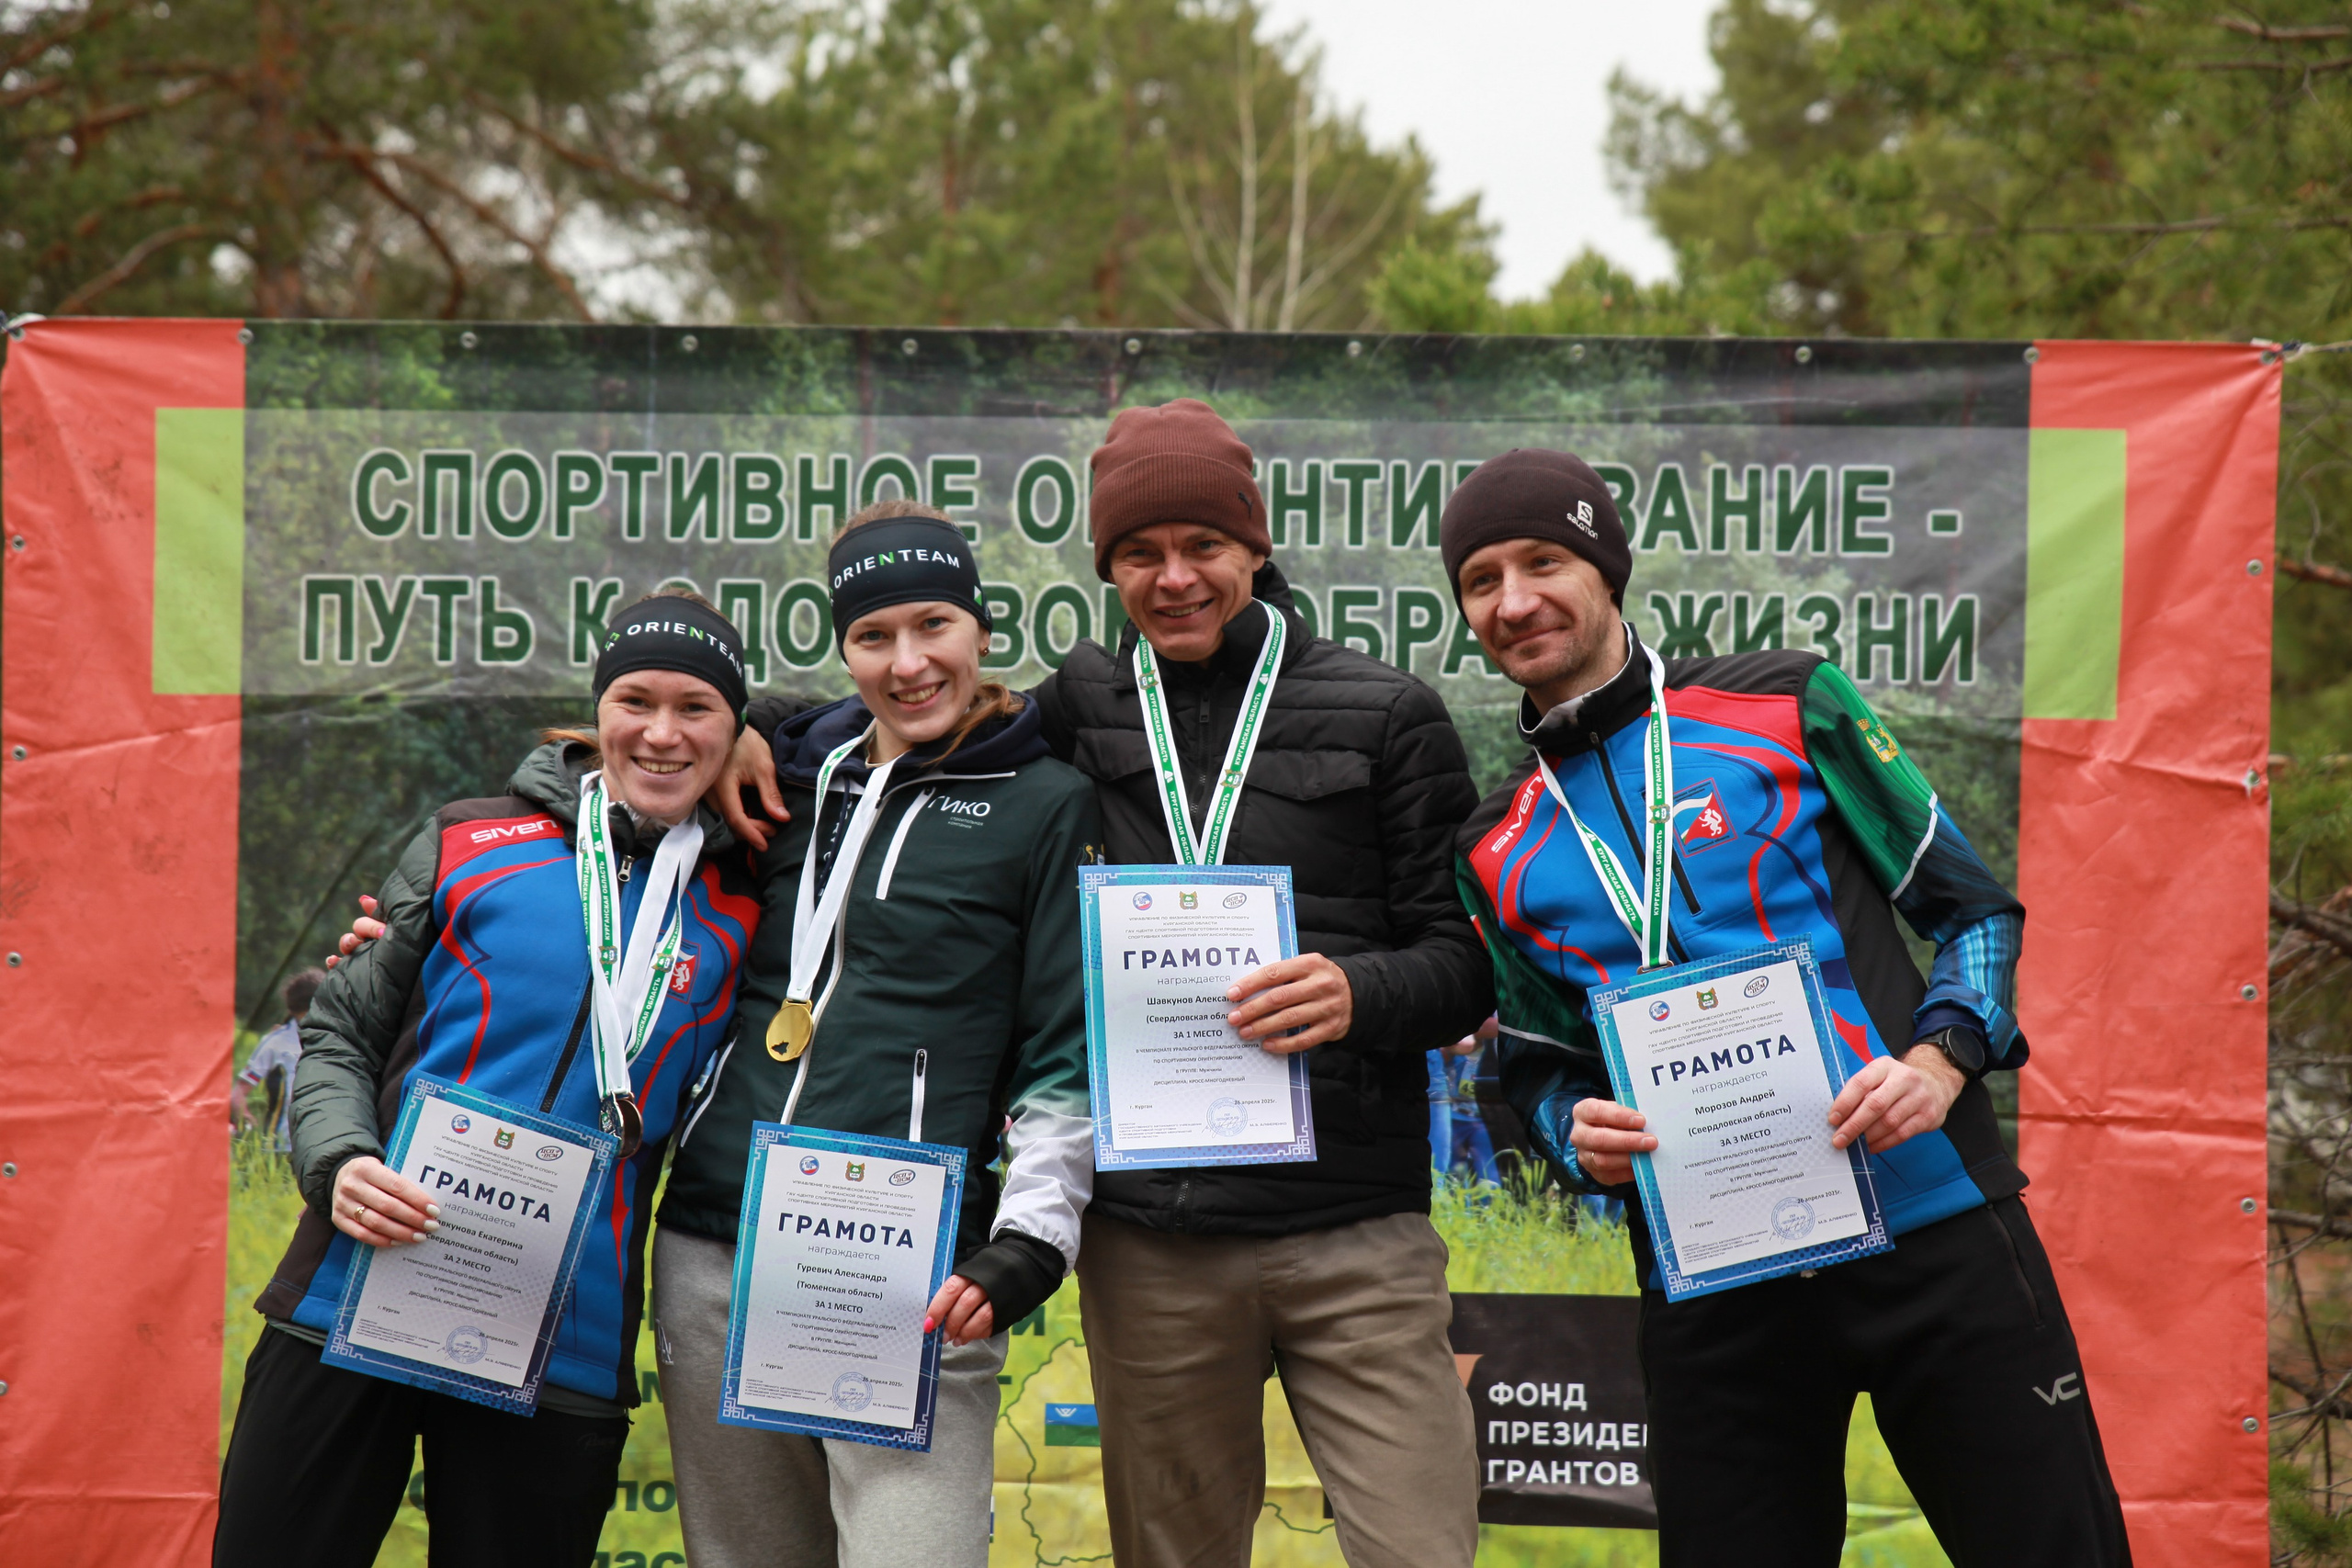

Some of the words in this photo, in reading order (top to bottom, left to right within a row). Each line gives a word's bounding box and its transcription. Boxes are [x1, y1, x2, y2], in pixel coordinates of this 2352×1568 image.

[1013, 454, 1895, 556] ОНТИВАНИЕ
[834, 549, 960, 589] ORIENTEAM
[301, 576, 536, 665] ПУТЬ
[571, 576, 623, 667] К
[1649, 587, 1981, 687] ЖИЗНИ
[1266, 625, 1282, 666] КУРГАНСКАЯ
[627, 621, 742, 678] ORIENTEAM
[1148, 693, 1162, 733] КУРГАНСКАЯ
[1157, 733, 1169, 762] ОБЛАСТЬ
[1235, 723, 1252, 765] КУРГАНСКАЯ
[1248, 693, 1261, 723] ОБЛАСТЬ
[1653, 720, 1661, 753] ОБЛАСТЬ
[1654, 754, 1663, 799] КУРГАНСКАЯ
[1170, 791, 1185, 835] КУРГАНСКАЯ
[1181, 837, 1193, 864] ОБЛАСТ
[1207, 826, 1221, 865] УРГАНСКАЯ
[1216, 793, 1230, 826] ОБЛАСТЬ
[599, 861, 609, 895] ОБЛАСТЬ
[1597, 847, 1622, 890] КУРГАНСКАЯ
[1618, 889, 1636, 921] ОБЛАСТЬ
[1654, 867, 1662, 916] КУРГАНСКАЯ
[602, 895, 611, 941] КУРГАНСКАЯ
[1123, 946, 1261, 970] ГРАМОТА
[1157, 975, 1230, 986] награждается
[633, 1011, 650, 1054] КУРГАНСКАЯ
[646, 977, 662, 1010] ОБЛАСТЬ
[1147, 997, 1193, 1006] Шавкунов
[1146, 1014, 1207, 1023] (Свердловская
[1173, 1031, 1183, 1039] ЗА
[1193, 1029, 1222, 1037] МЕСТО
[1650, 1033, 1796, 1086] ГРАМОТА
[1691, 1070, 1768, 1095] награждается
[1694, 1100, 1737, 1115] Морозов
[1739, 1089, 1775, 1104] Андрей
[1688, 1115, 1752, 1137] (Свердловская
[1754, 1104, 1791, 1120] область)
[1719, 1137, 1732, 1146] ЗА
[1733, 1135, 1738, 1144] 3
[1739, 1128, 1770, 1142] МЕСТО
[418, 1164, 549, 1223] ГРАМОТА
[444, 1201, 515, 1228] награждается
[778, 1212, 913, 1248] ГРАМОТА
[433, 1216, 476, 1235] авкунова
[478, 1230, 523, 1249] Екатерина
[443, 1253, 453, 1262] ЗА
[461, 1258, 491, 1272] МЕСТО
[483, 1250, 518, 1266] область)
[808, 1245, 879, 1260] награждается
[797, 1262, 831, 1274] Гуревич
[833, 1268, 887, 1282] Александра
[797, 1280, 845, 1293] (Тюменская
[847, 1288, 882, 1301] область)
[814, 1300, 825, 1308] ЗА
[833, 1303, 863, 1314] МЕСТО
[1488, 1382, 1588, 1411] ФОНД
[1488, 1420, 1647, 1450] ПРЕЗИДЕ
[1487, 1459, 1640, 1486] ГРАНТОВ
